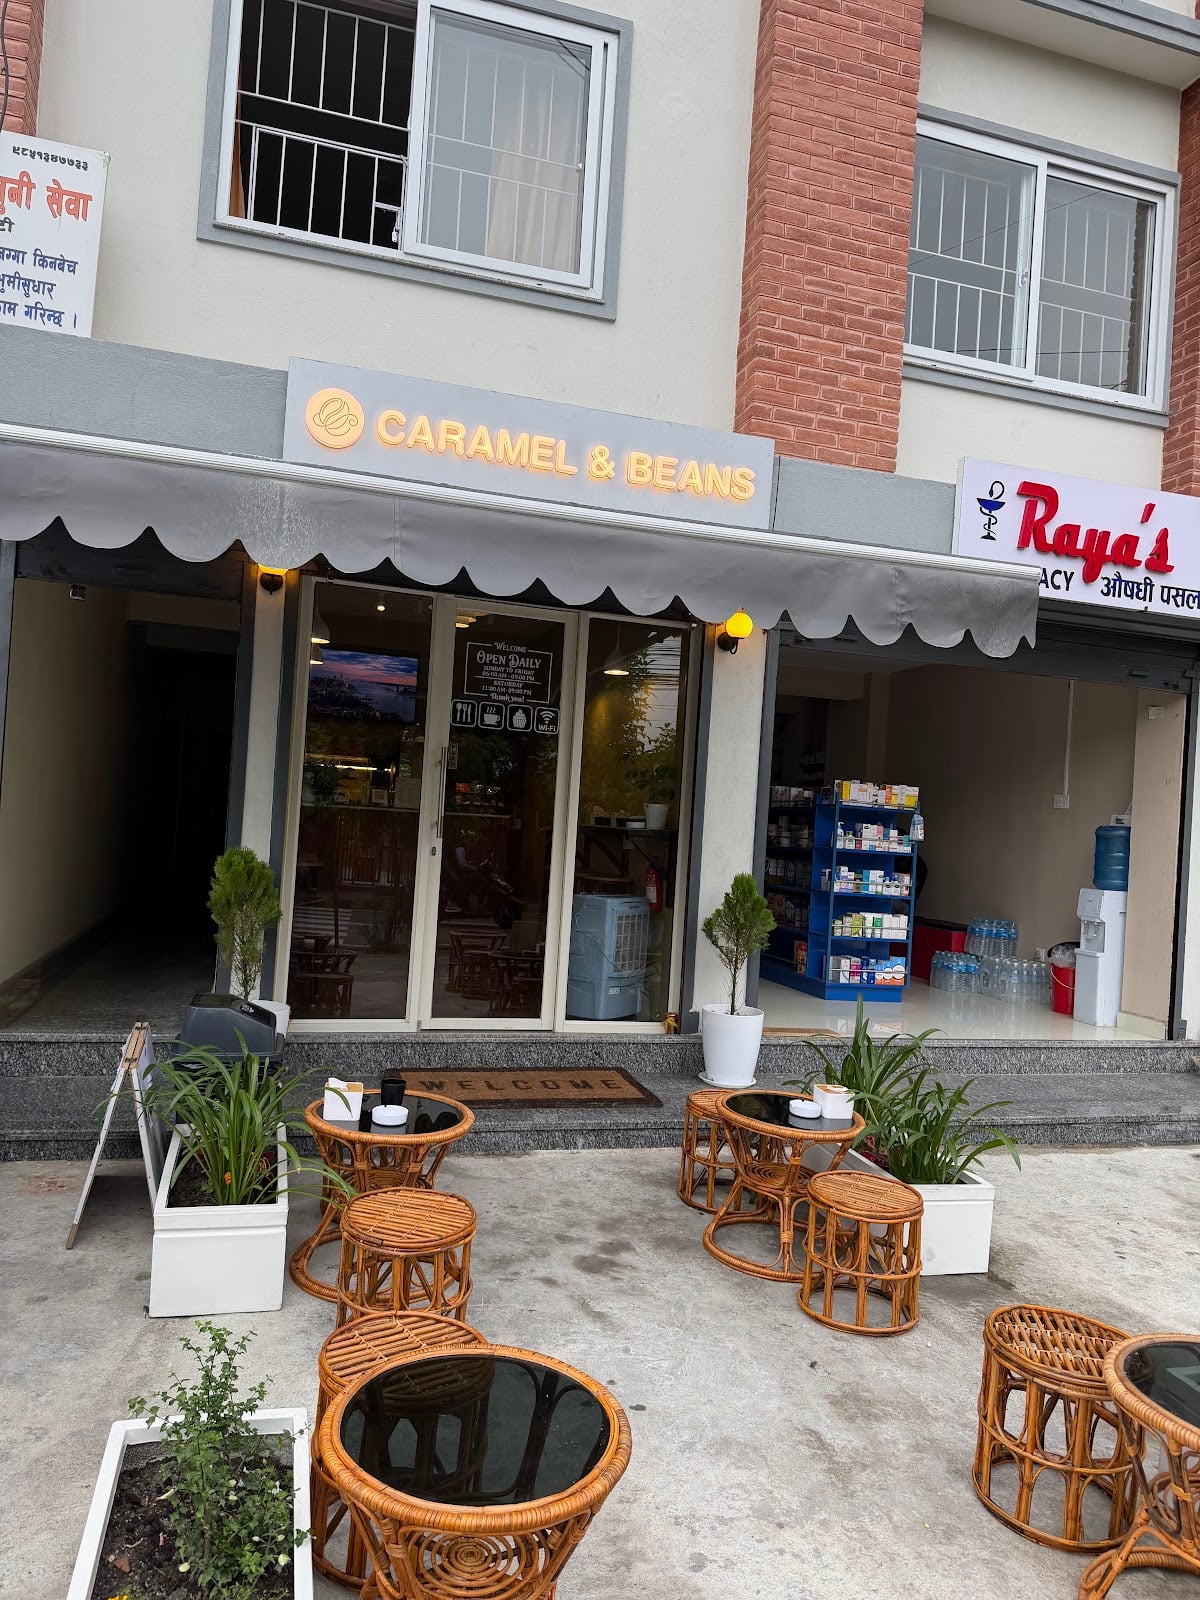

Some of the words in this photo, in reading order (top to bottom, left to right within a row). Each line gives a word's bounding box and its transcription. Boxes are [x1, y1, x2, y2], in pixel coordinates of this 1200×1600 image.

[46, 178, 93, 221] सेवा
[33, 248, 78, 275] किनबेच
[0, 300, 18, 317] ाम
[24, 301, 65, 327] गरिन्छ
[376, 409, 578, 476] CARAMEL
[588, 445, 616, 479] &
[627, 451, 755, 500] BEANS
[1016, 481, 1175, 584] Raya's
[1100, 571, 1155, 603] औषधी
[476, 650, 506, 665] OPEN
[509, 653, 541, 669] DAILY
[493, 680, 524, 688] SATURDAY
[418, 1078, 624, 1092] WELCOME
